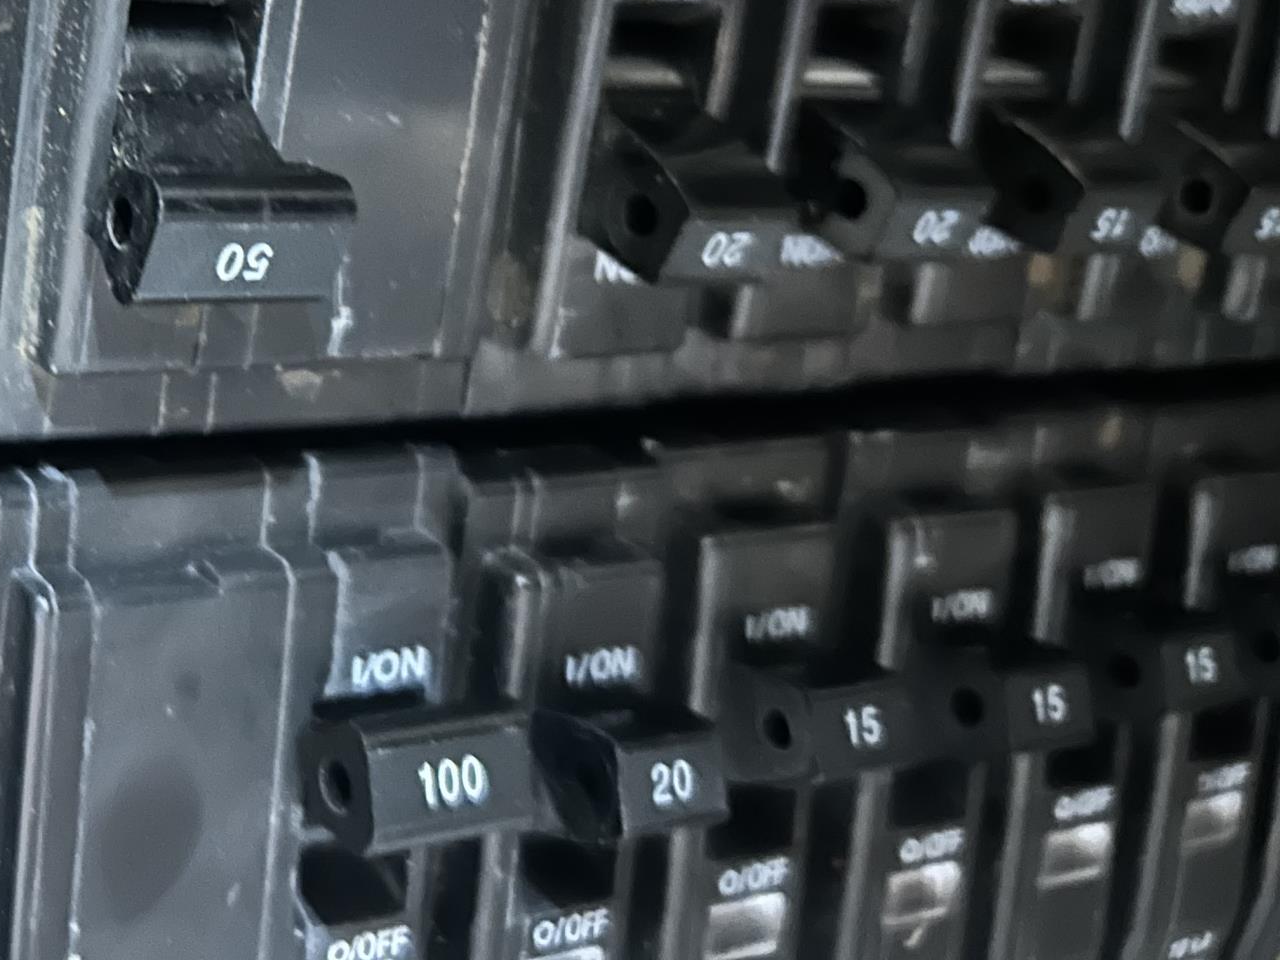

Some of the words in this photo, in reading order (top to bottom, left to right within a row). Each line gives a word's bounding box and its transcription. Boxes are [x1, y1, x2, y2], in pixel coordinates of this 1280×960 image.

[913, 208, 960, 247] 20
[1090, 207, 1131, 242] 15
[216, 242, 274, 282] 50
[701, 231, 755, 269] 20
[352, 644, 430, 686] I/ON
[566, 645, 636, 683] I/ON
[1185, 645, 1218, 683] 15
[1032, 683, 1069, 724] 15
[844, 704, 886, 747] 15
[419, 754, 489, 810] 100
[650, 758, 695, 807] 20
[718, 856, 790, 896] O/OFF
[326, 924, 410, 960] O/OFF
[533, 907, 608, 947] O/OFF
